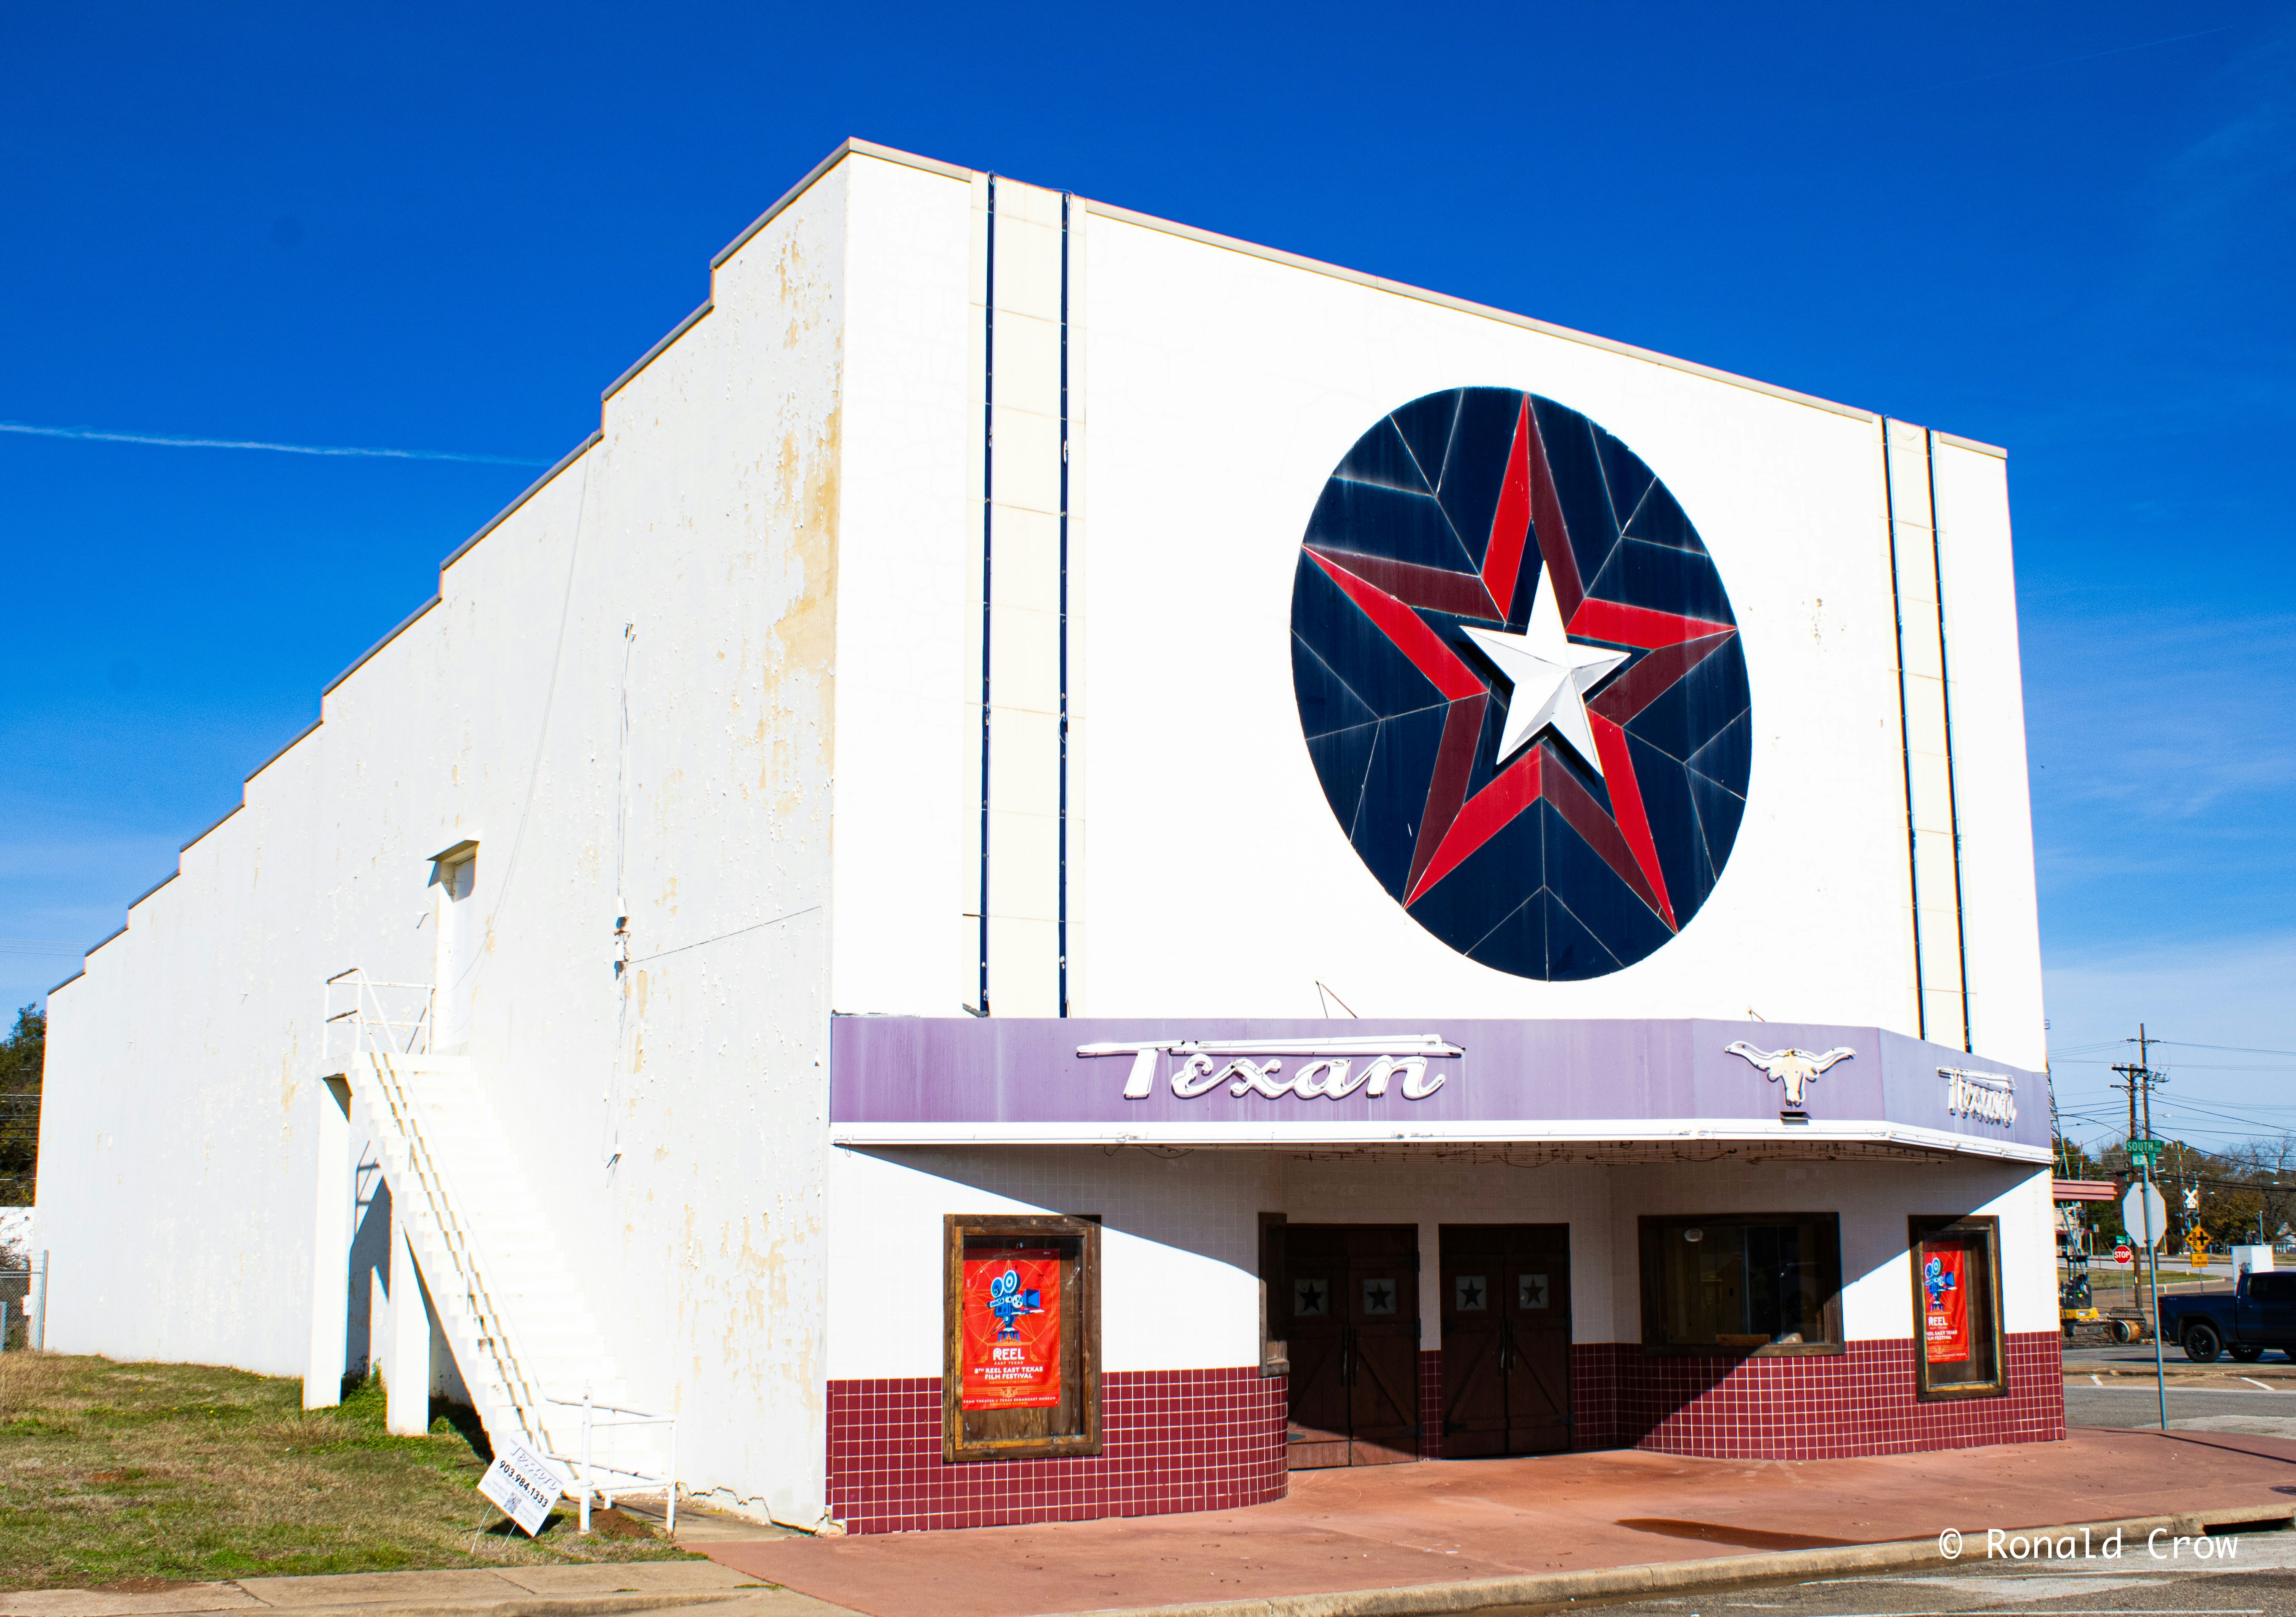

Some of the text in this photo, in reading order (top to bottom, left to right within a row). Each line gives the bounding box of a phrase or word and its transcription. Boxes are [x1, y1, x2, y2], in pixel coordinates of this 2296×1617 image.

[1076, 1034, 1466, 1100] Texan
[1936, 1066, 2018, 1125] Texan
[2127, 1141, 2153, 1151] SOUTH
[1928, 1316, 1948, 1326] REEL
[993, 1348, 1025, 1360] REEL
[500, 1460, 549, 1507] 903.984.1333
[514, 1461, 543, 1488] EVENT VENUE
